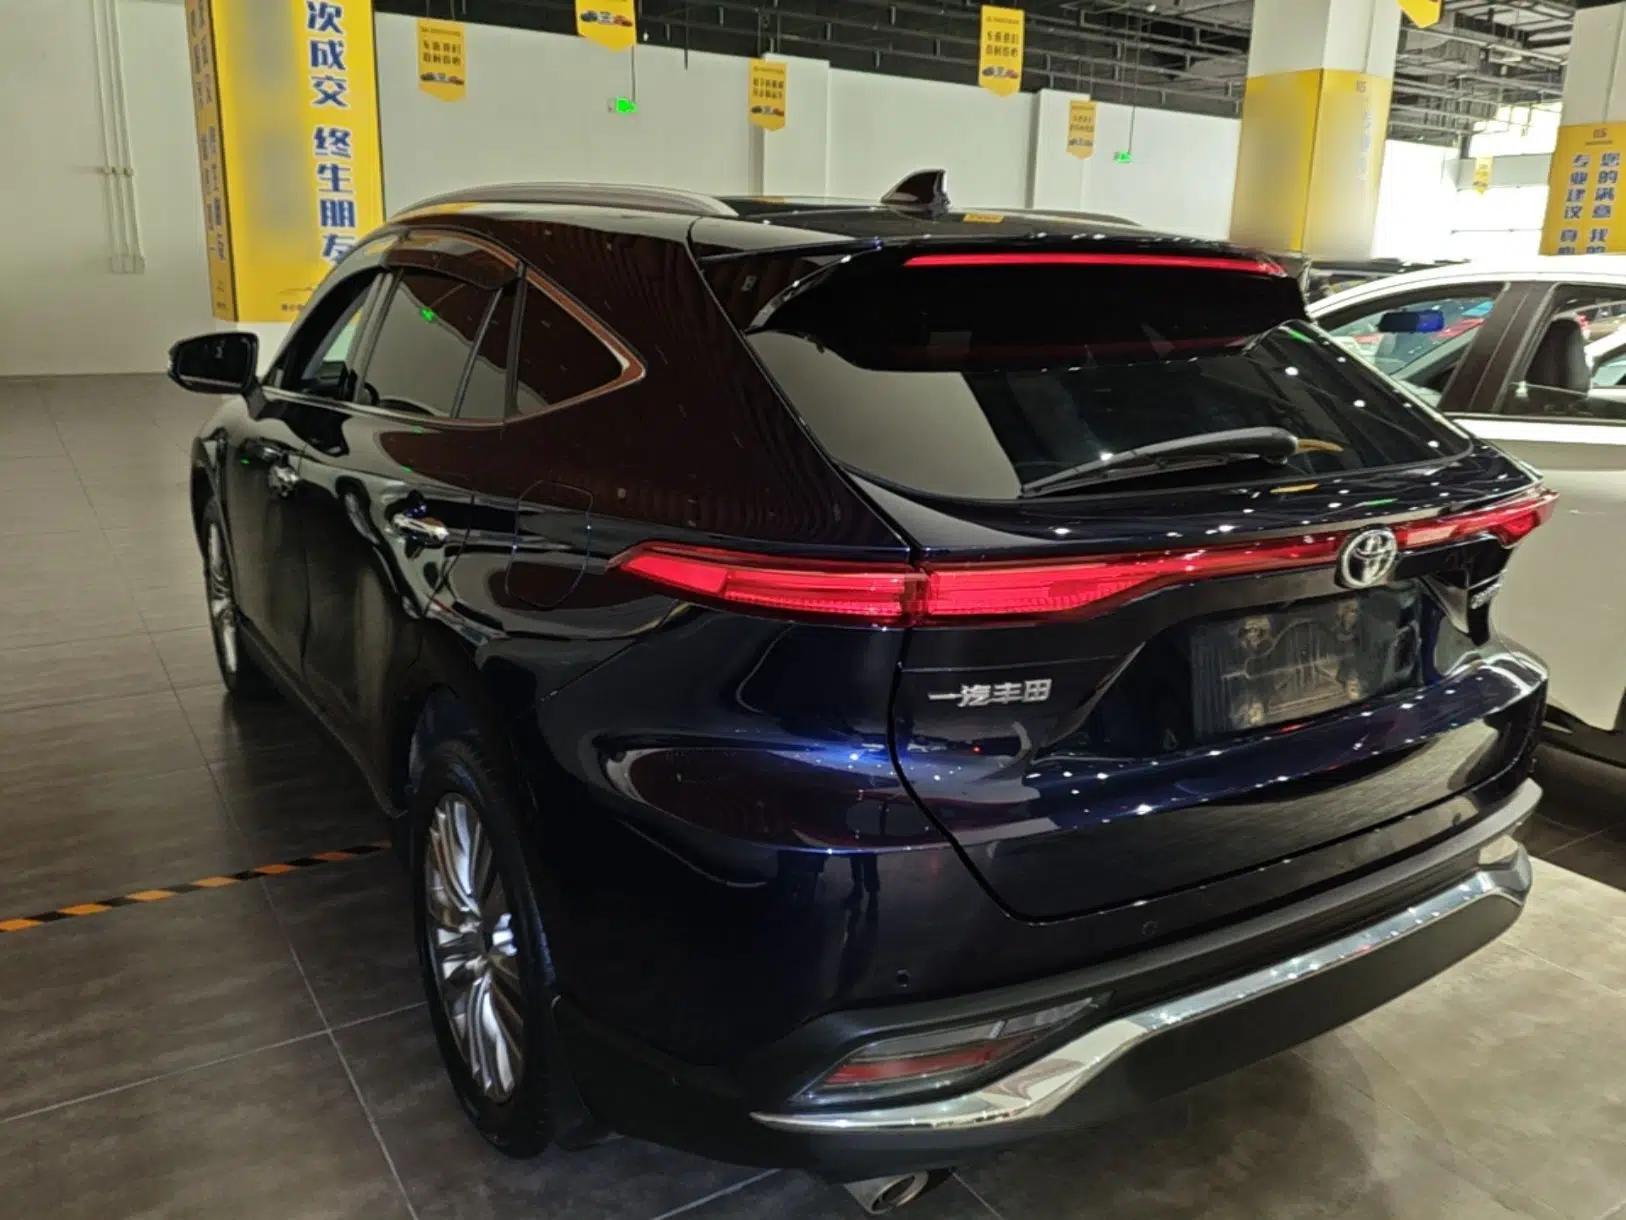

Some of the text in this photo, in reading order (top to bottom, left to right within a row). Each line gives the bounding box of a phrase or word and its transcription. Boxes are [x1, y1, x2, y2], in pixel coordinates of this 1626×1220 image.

[307, 0, 356, 263] 次成交 终生朋友
[928, 679, 1052, 707] 一汽丰田
